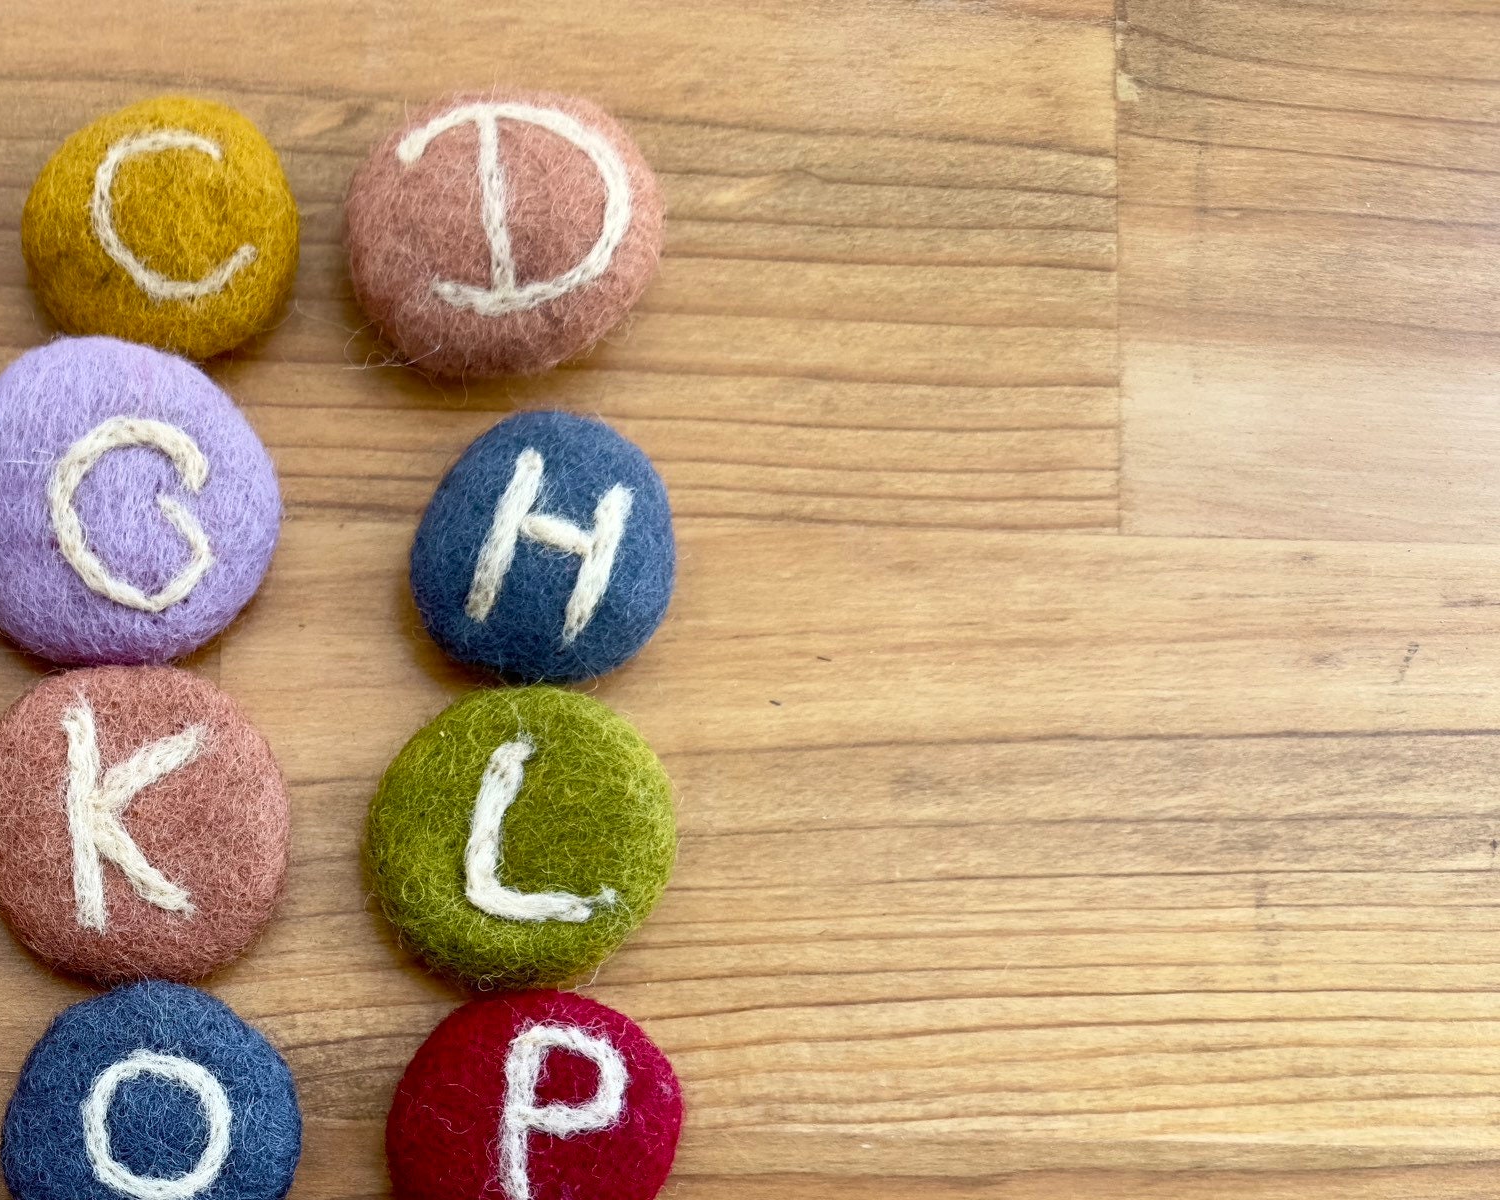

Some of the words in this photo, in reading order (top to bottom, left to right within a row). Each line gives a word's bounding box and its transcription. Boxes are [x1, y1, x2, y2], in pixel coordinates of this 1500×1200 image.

[92, 131, 254, 297] C
[397, 103, 634, 313] D
[50, 417, 213, 610] G
[472, 449, 634, 640] H
[62, 700, 208, 930] K
[466, 737, 616, 920] L
